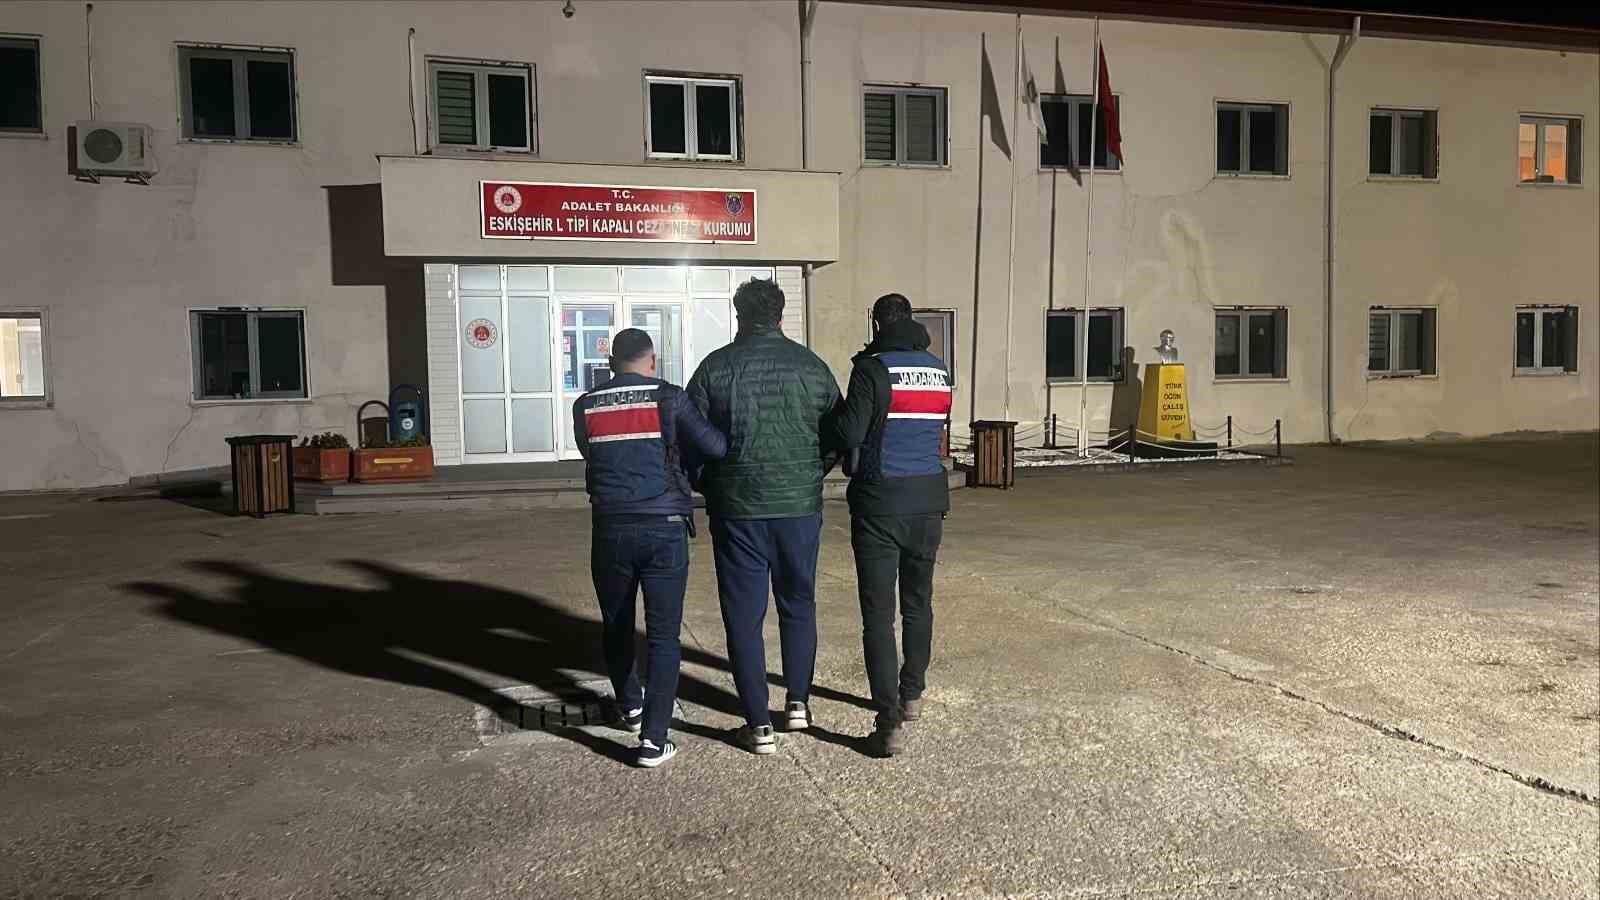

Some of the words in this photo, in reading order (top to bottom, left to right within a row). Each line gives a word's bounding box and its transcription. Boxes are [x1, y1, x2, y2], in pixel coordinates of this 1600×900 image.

[611, 189, 635, 200] T.C.
[561, 201, 612, 212] ADALET
[489, 214, 553, 234] ESKİŞEHİR
[556, 218, 563, 232] L
[567, 215, 589, 233] TİPİ
[593, 218, 633, 234] KAPALI
[704, 221, 751, 236] KURUMU
[898, 371, 947, 387] JANDARMA
